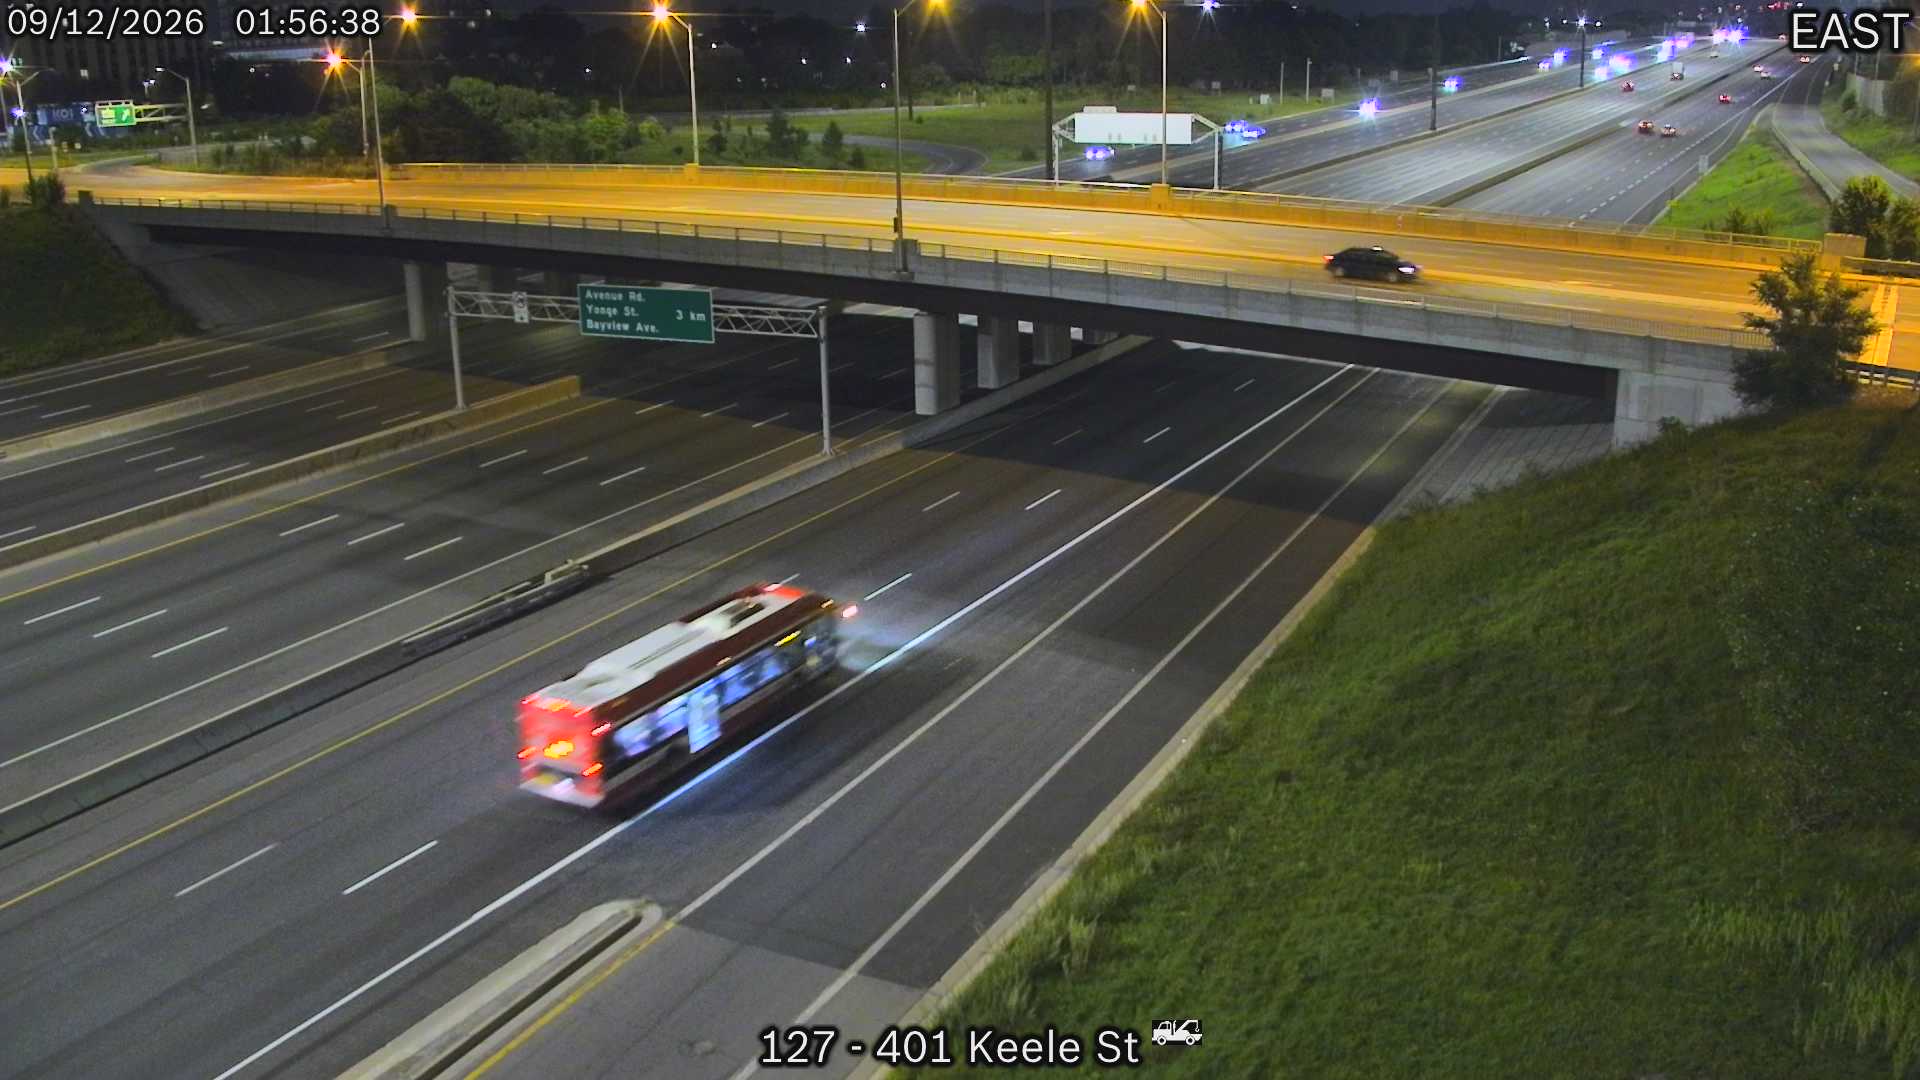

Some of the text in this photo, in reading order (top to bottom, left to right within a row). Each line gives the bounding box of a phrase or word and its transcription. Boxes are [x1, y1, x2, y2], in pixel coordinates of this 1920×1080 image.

[585, 290, 623, 301] Avenue
[586, 304, 618, 318] Yonge
[675, 310, 706, 321] 3 km
[586, 319, 629, 332] Bayview
